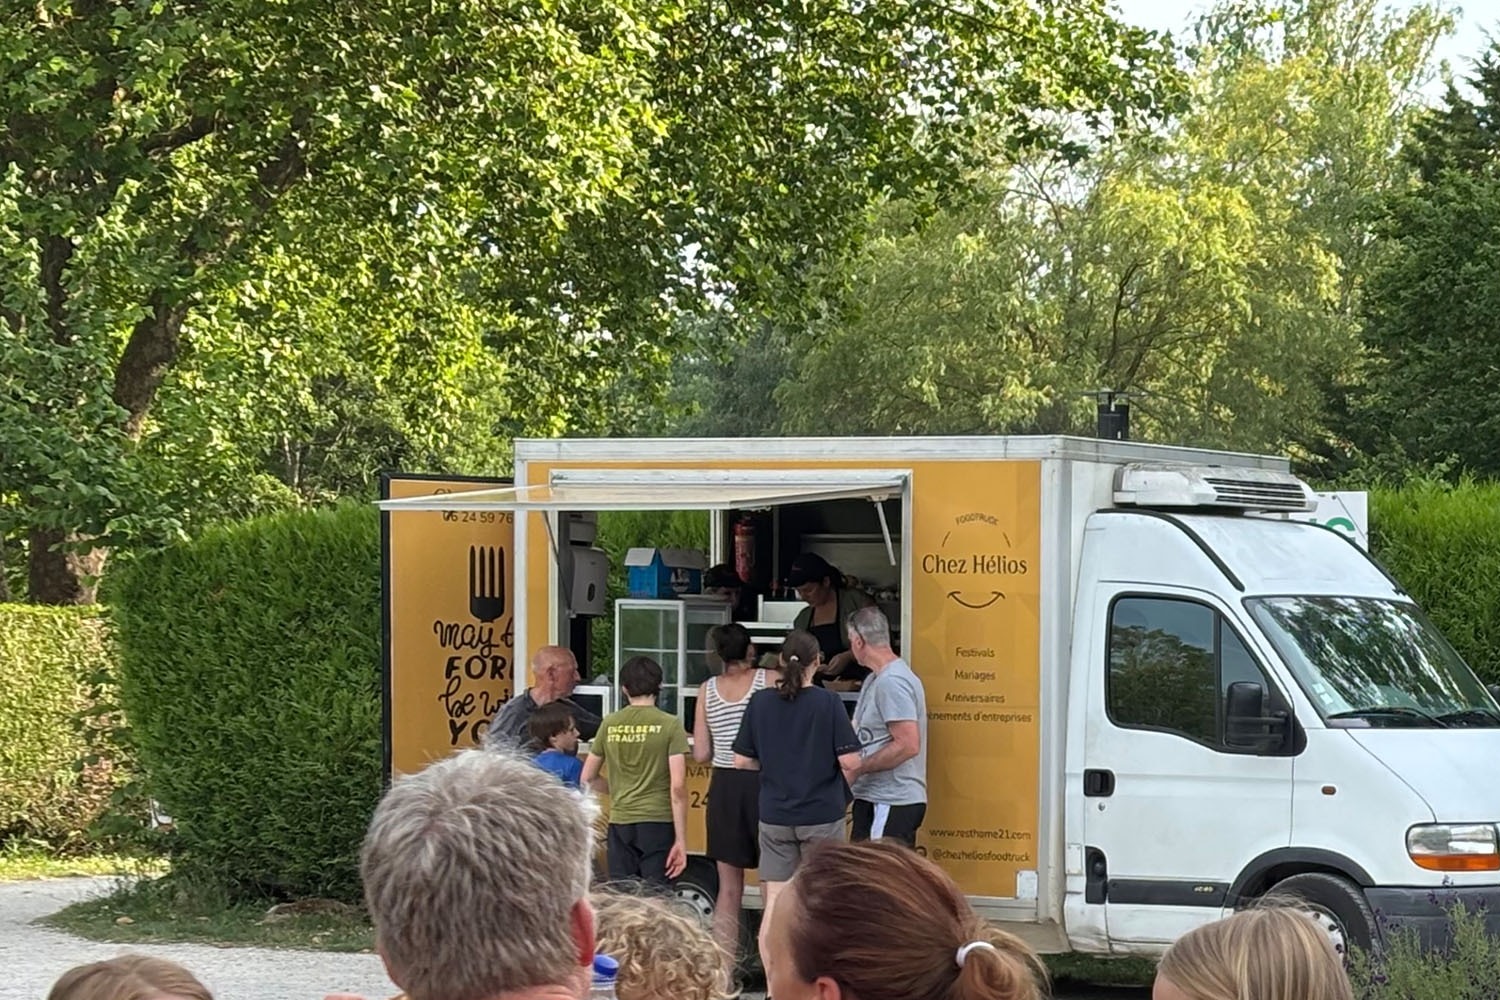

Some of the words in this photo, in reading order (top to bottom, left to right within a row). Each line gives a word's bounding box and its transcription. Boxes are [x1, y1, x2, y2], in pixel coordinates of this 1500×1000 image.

[462, 512, 477, 523] 24
[480, 512, 495, 523] 59
[955, 512, 999, 527] FOODTRUCK
[922, 554, 967, 575] Chez
[973, 555, 1028, 575] Hélios
[433, 619, 499, 659] may
[956, 647, 995, 659] Festivals
[445, 655, 514, 680] FOR
[955, 669, 996, 682] Mariages
[438, 676, 476, 718] be
[945, 692, 1005, 704] Anniversaires
[607, 725, 662, 734] ENGELBERT
[607, 734, 647, 743] STRAUSS
[929, 829, 1031, 840] www.resthome21.com
[933, 848, 1030, 861] @chezheliosfoodtruck
